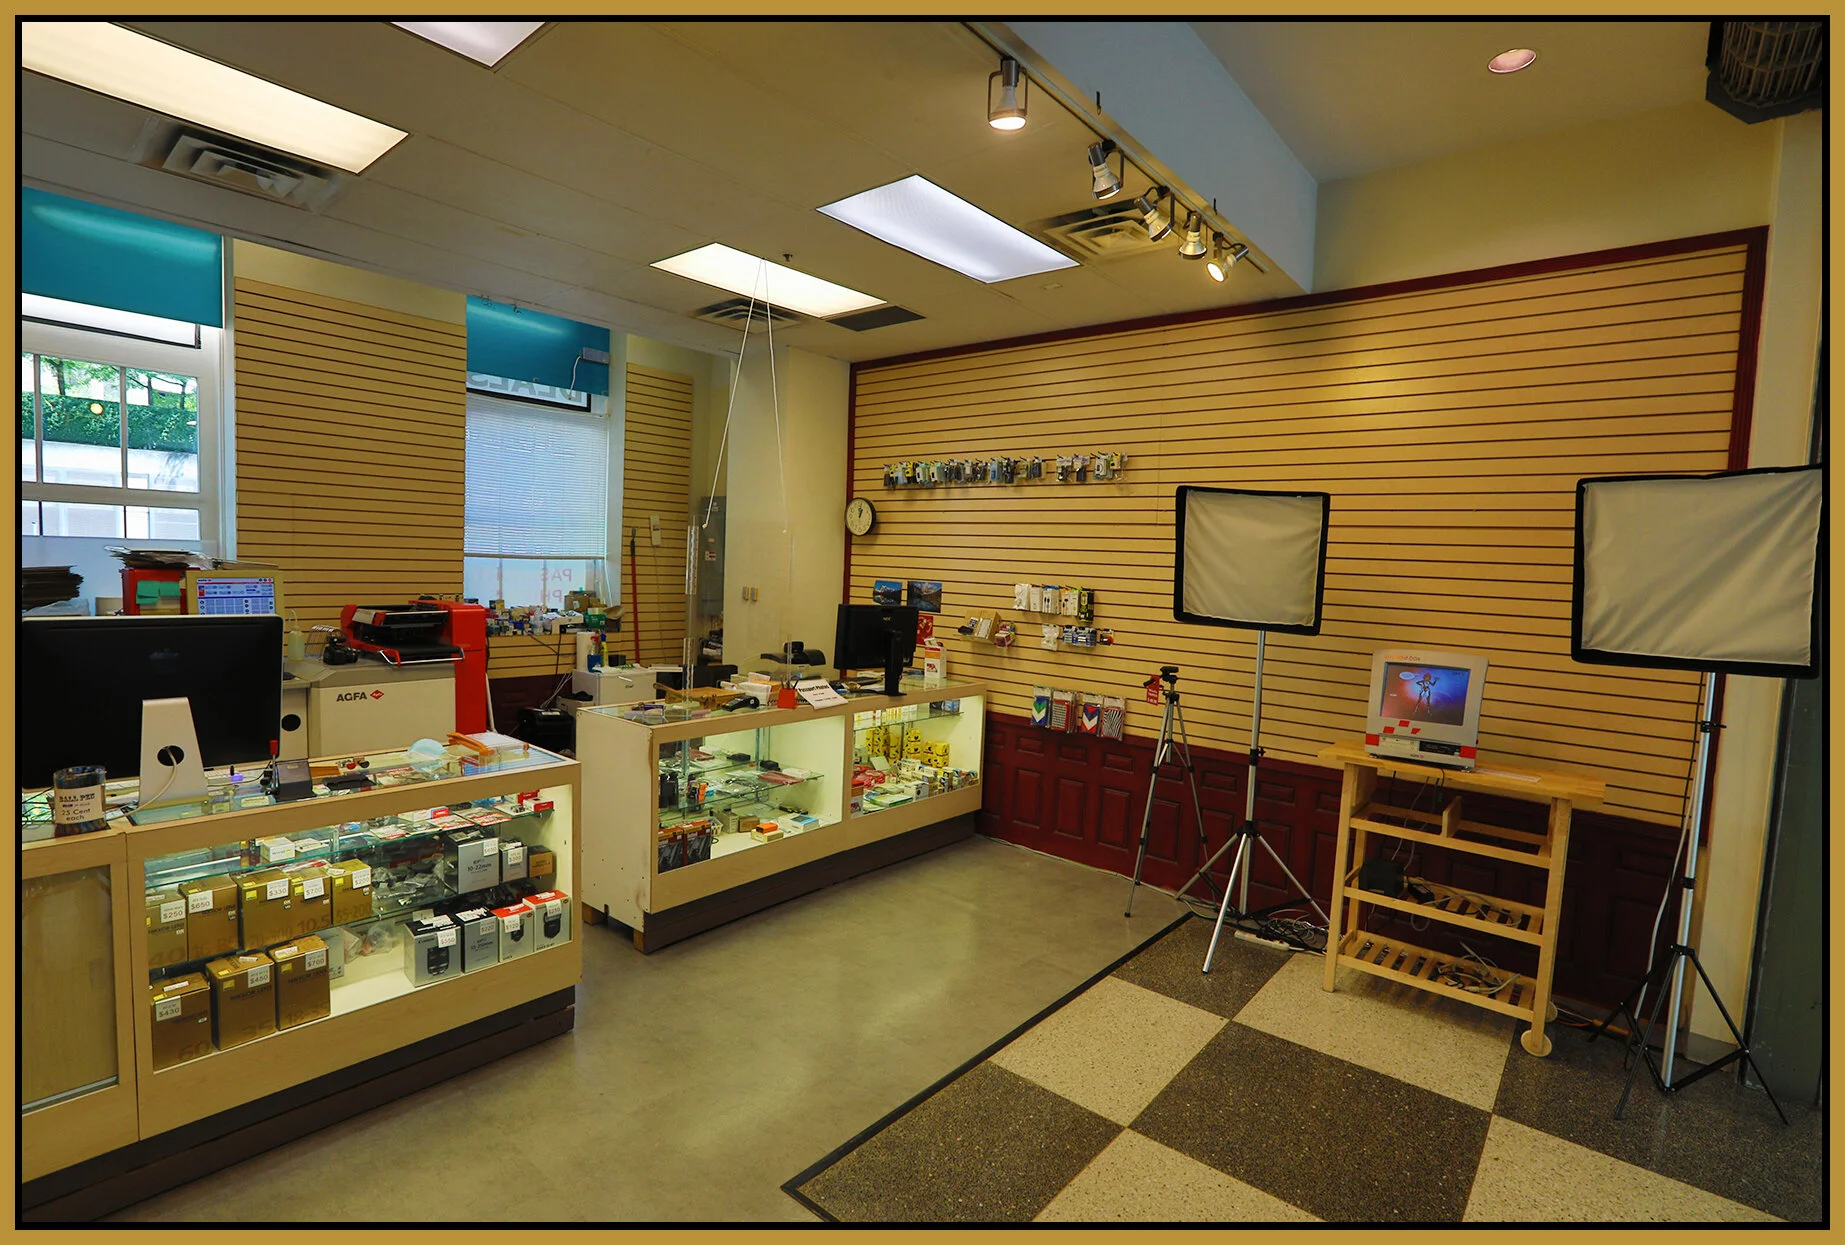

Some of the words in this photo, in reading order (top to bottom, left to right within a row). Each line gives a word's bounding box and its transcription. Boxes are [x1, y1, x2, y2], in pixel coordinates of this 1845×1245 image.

[336, 691, 367, 702] AGFA
[59, 795, 78, 803] BALL
[73, 808, 91, 816] Cent
[269, 888, 287, 897] $330
[190, 900, 210, 911] $650
[163, 910, 183, 920] $250
[297, 914, 330, 933] 10.5
[307, 959, 324, 968] $700
[250, 975, 269, 985] $450
[159, 1007, 179, 1018] $430
